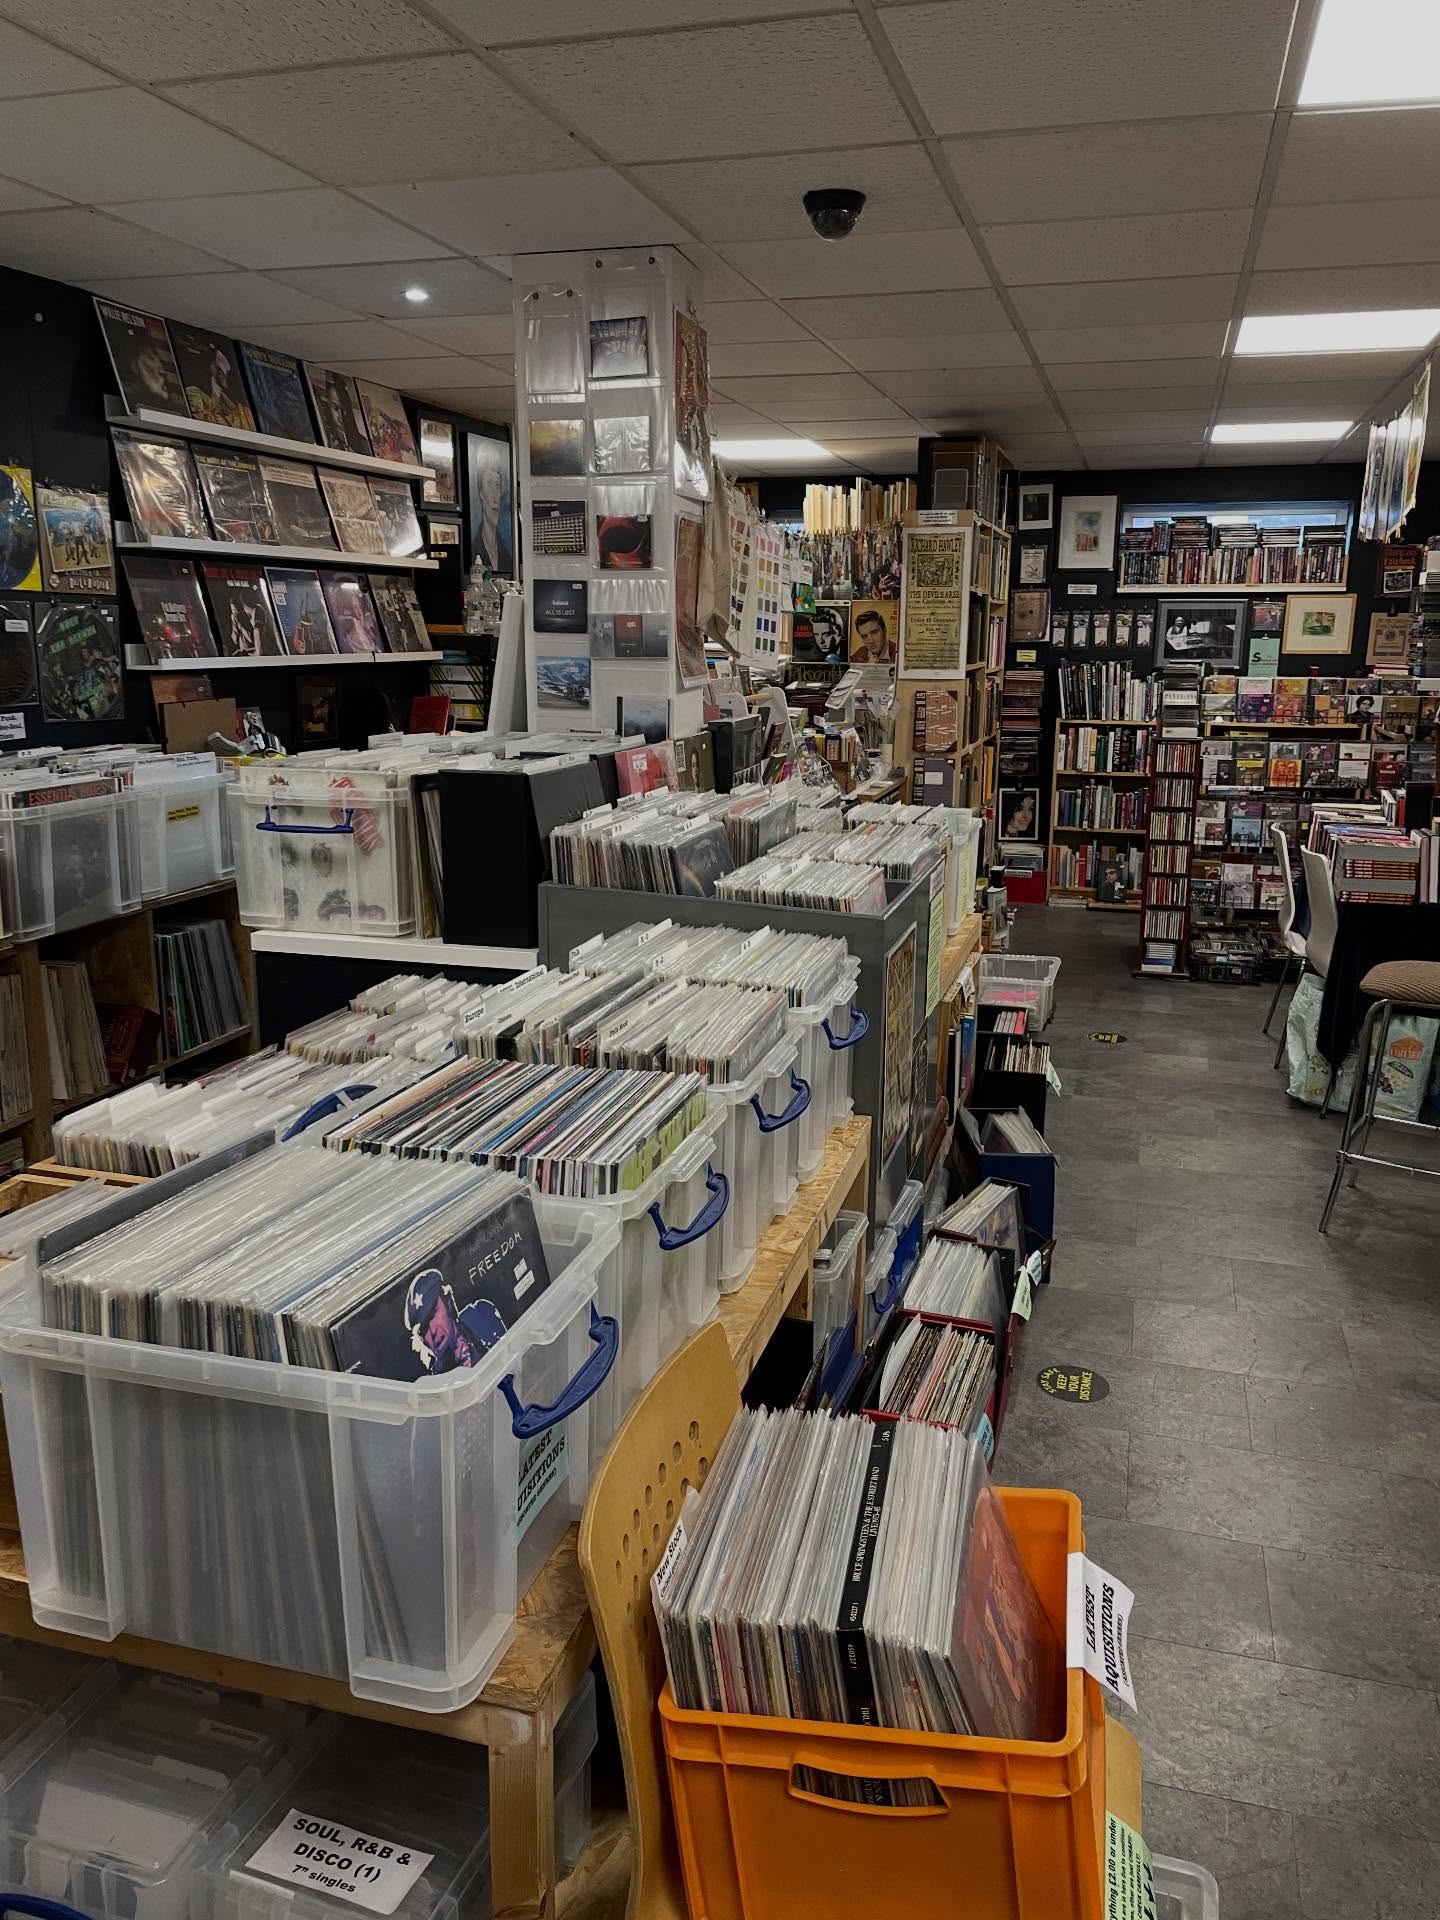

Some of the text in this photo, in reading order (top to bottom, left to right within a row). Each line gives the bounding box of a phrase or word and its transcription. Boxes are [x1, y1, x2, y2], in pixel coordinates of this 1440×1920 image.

[910, 591, 921, 599] THE
[944, 591, 960, 599] ARSE
[463, 1006, 486, 1025] Europe
[468, 1232, 523, 1286] FREEDOM
[1040, 1367, 1061, 1394] STAY SAFE
[1056, 1373, 1068, 1390] KEEP
[1067, 1375, 1080, 1392] YOUR
[1079, 1371, 1093, 1401] DISTANCE
[866, 1480, 878, 1500] STREET
[863, 1504, 874, 1517] THE
[656, 1525, 683, 1585] New Stock
[855, 1523, 871, 1562] SPRINGSTEEN
[851, 1561, 863, 1583] BRUCE
[1085, 1584, 1096, 1653] LATEST
[1101, 1582, 1119, 1693] AQUISITIONS
[847, 1643, 857, 1665] 450227
[293, 1818, 412, 1866] SOUL, R&B &
[1108, 1818, 1117, 1846] under
[293, 1842, 382, 1884] DISCO (1)
[1110, 1849, 1116, 1857] or
[291, 1864, 357, 1893] 7" singles
[1108, 1858, 1116, 1886] £2.00
